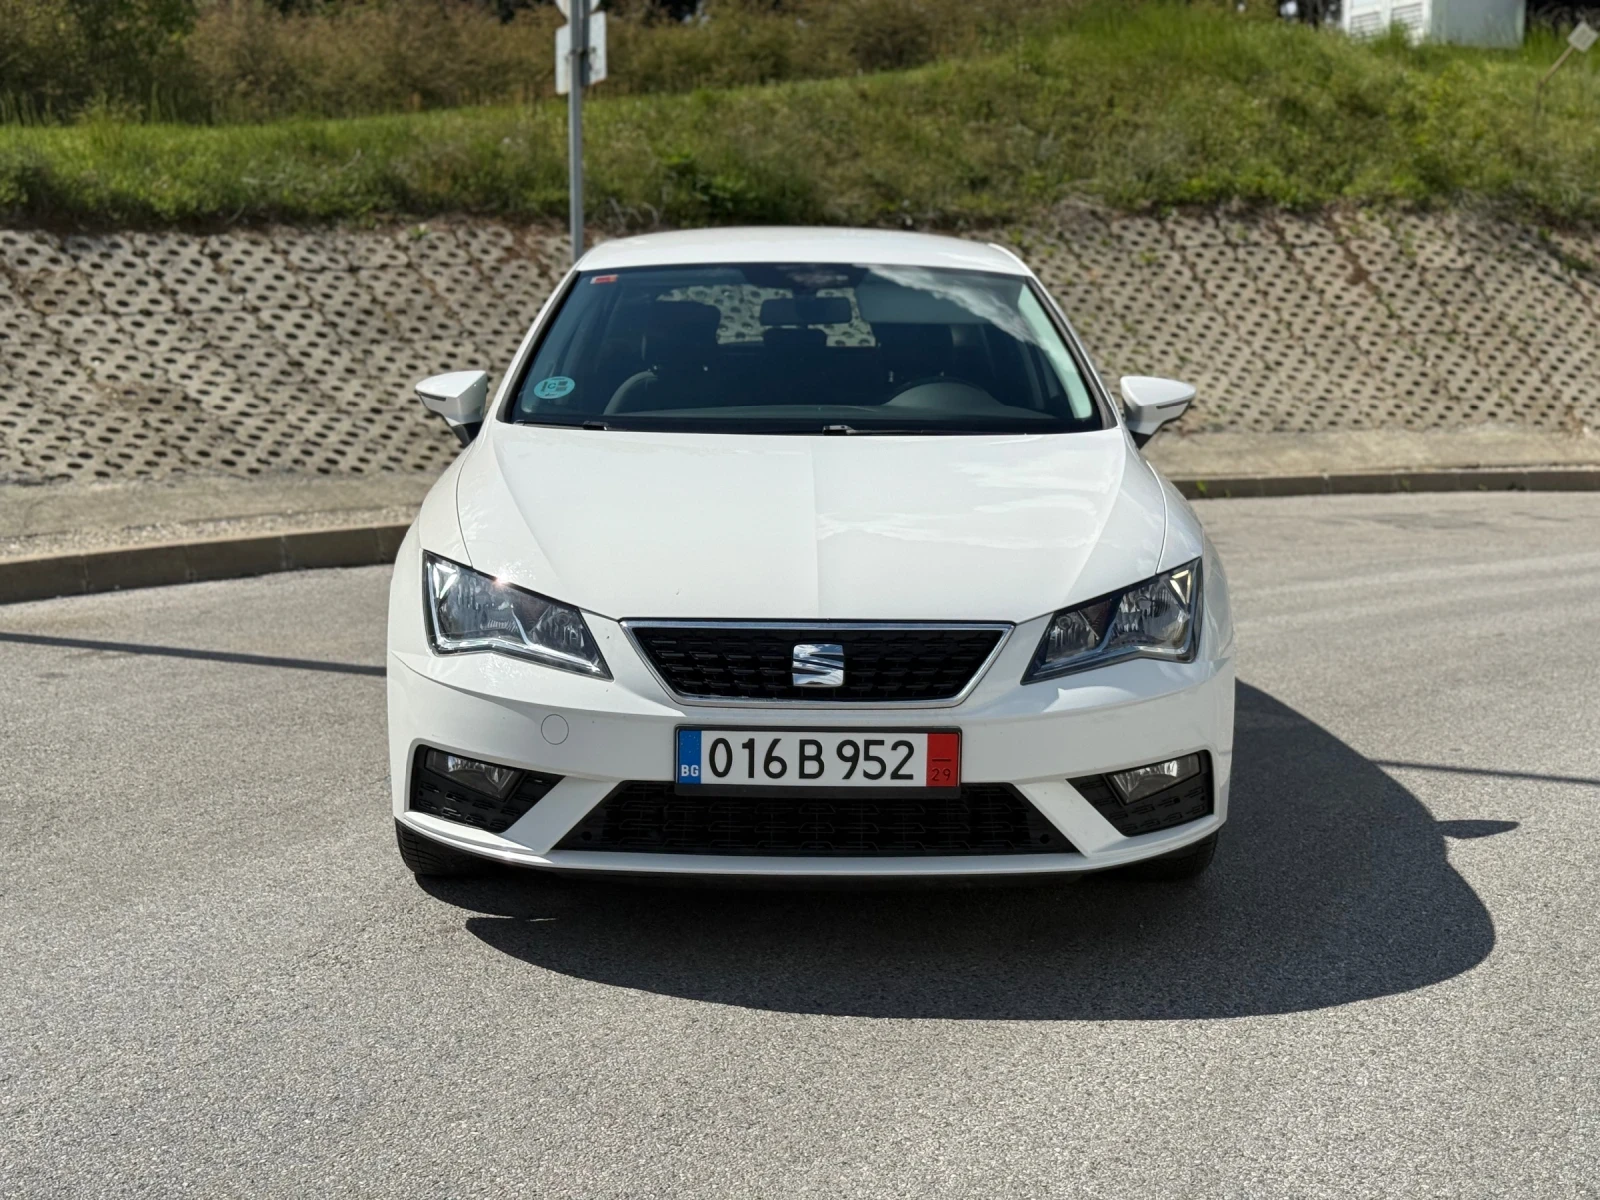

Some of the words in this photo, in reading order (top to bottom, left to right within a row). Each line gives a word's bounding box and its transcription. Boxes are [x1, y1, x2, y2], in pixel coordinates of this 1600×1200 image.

[708, 737, 788, 780] 016
[798, 738, 825, 780] B
[835, 739, 915, 781] 952
[680, 764, 700, 777] BG
[931, 767, 952, 782] 29
